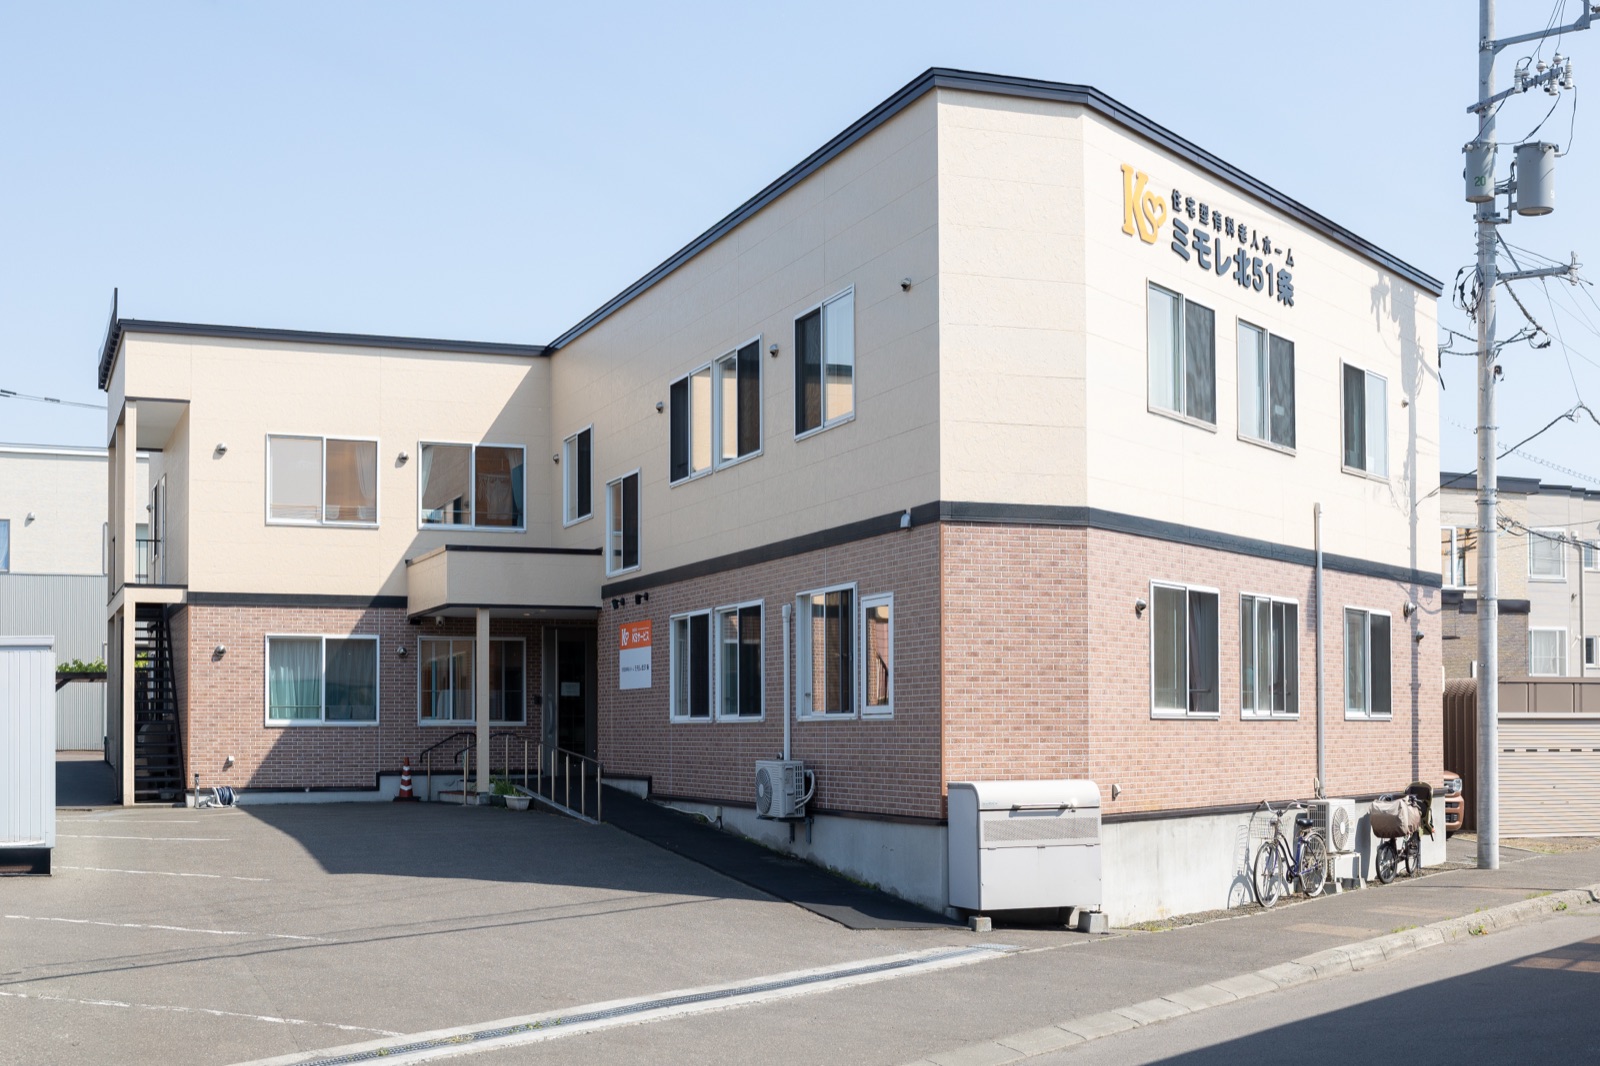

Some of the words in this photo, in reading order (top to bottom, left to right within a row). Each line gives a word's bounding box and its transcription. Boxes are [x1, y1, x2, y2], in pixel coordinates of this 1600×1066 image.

[1474, 175, 1486, 187] 20
[1171, 188, 1295, 267] 住宅型有料老人ホーム
[1171, 217, 1295, 307] ミモレ北51条
